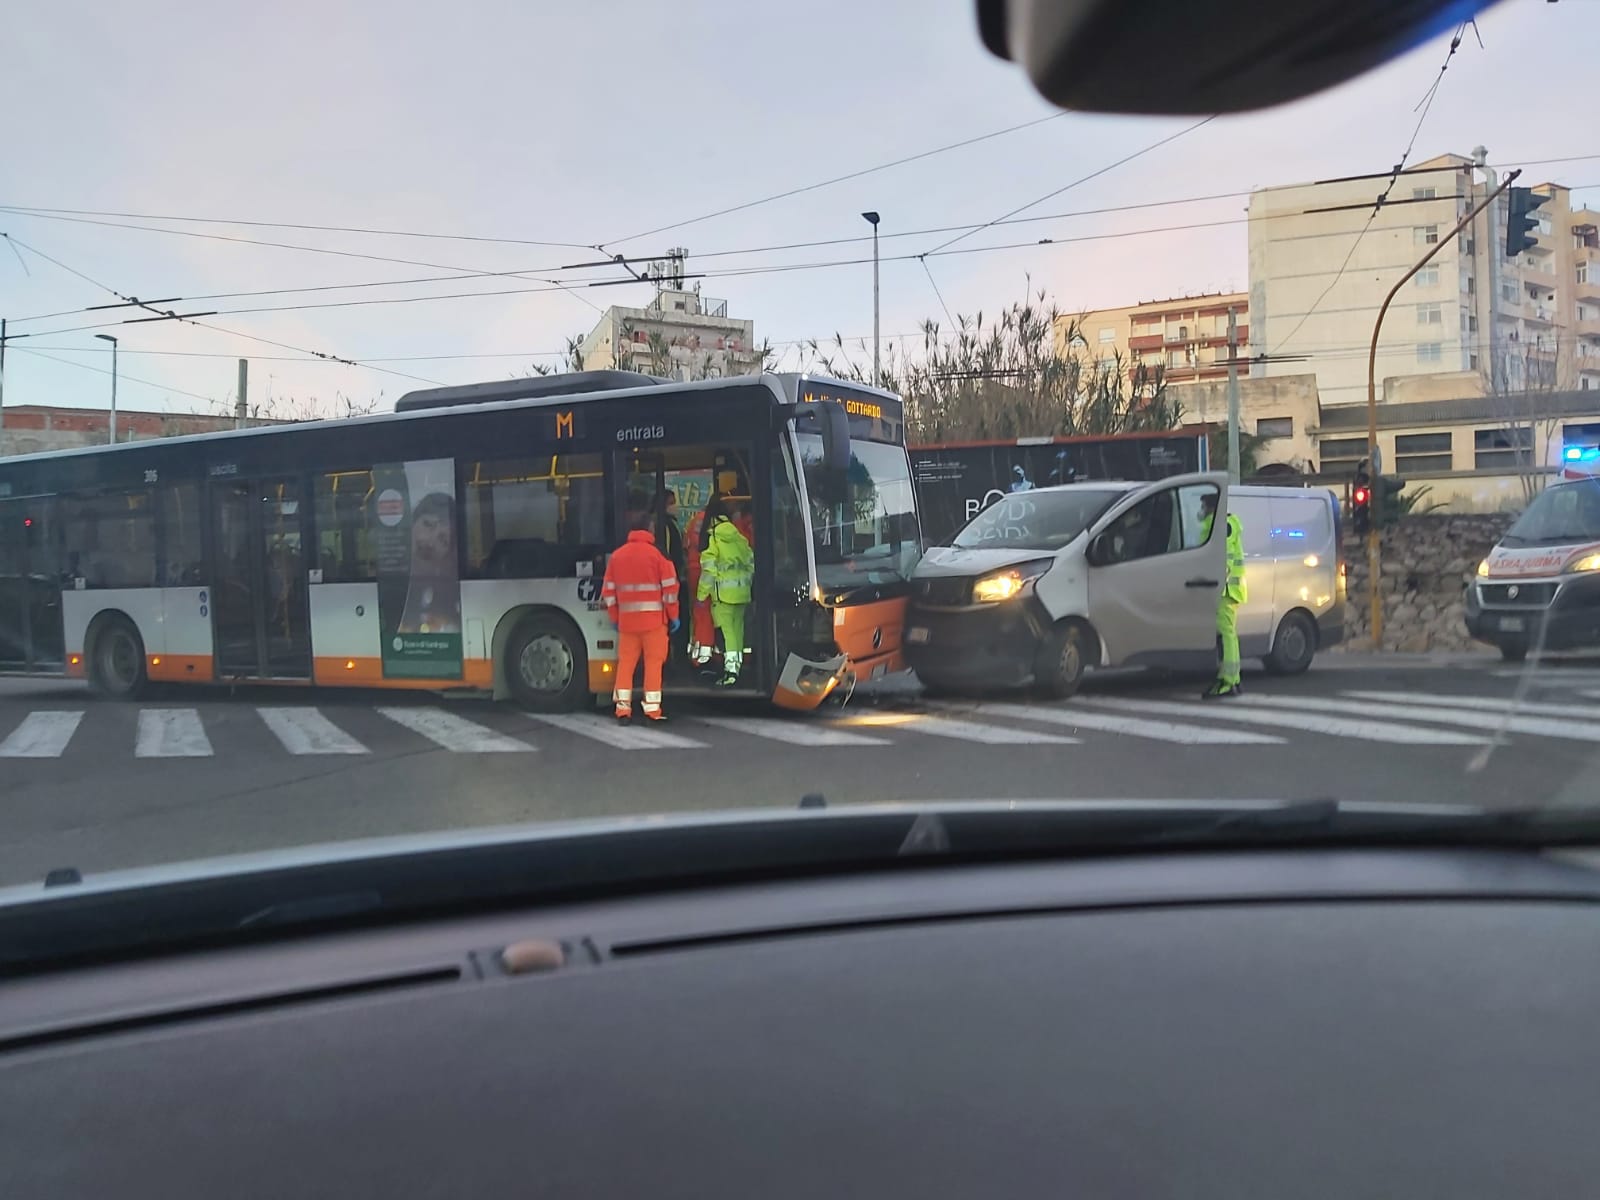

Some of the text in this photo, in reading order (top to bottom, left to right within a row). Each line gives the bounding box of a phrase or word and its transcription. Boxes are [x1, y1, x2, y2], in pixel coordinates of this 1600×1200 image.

[846, 400, 881, 418] GOTTARDO
[556, 411, 574, 439] M
[616, 425, 665, 441] entrata
